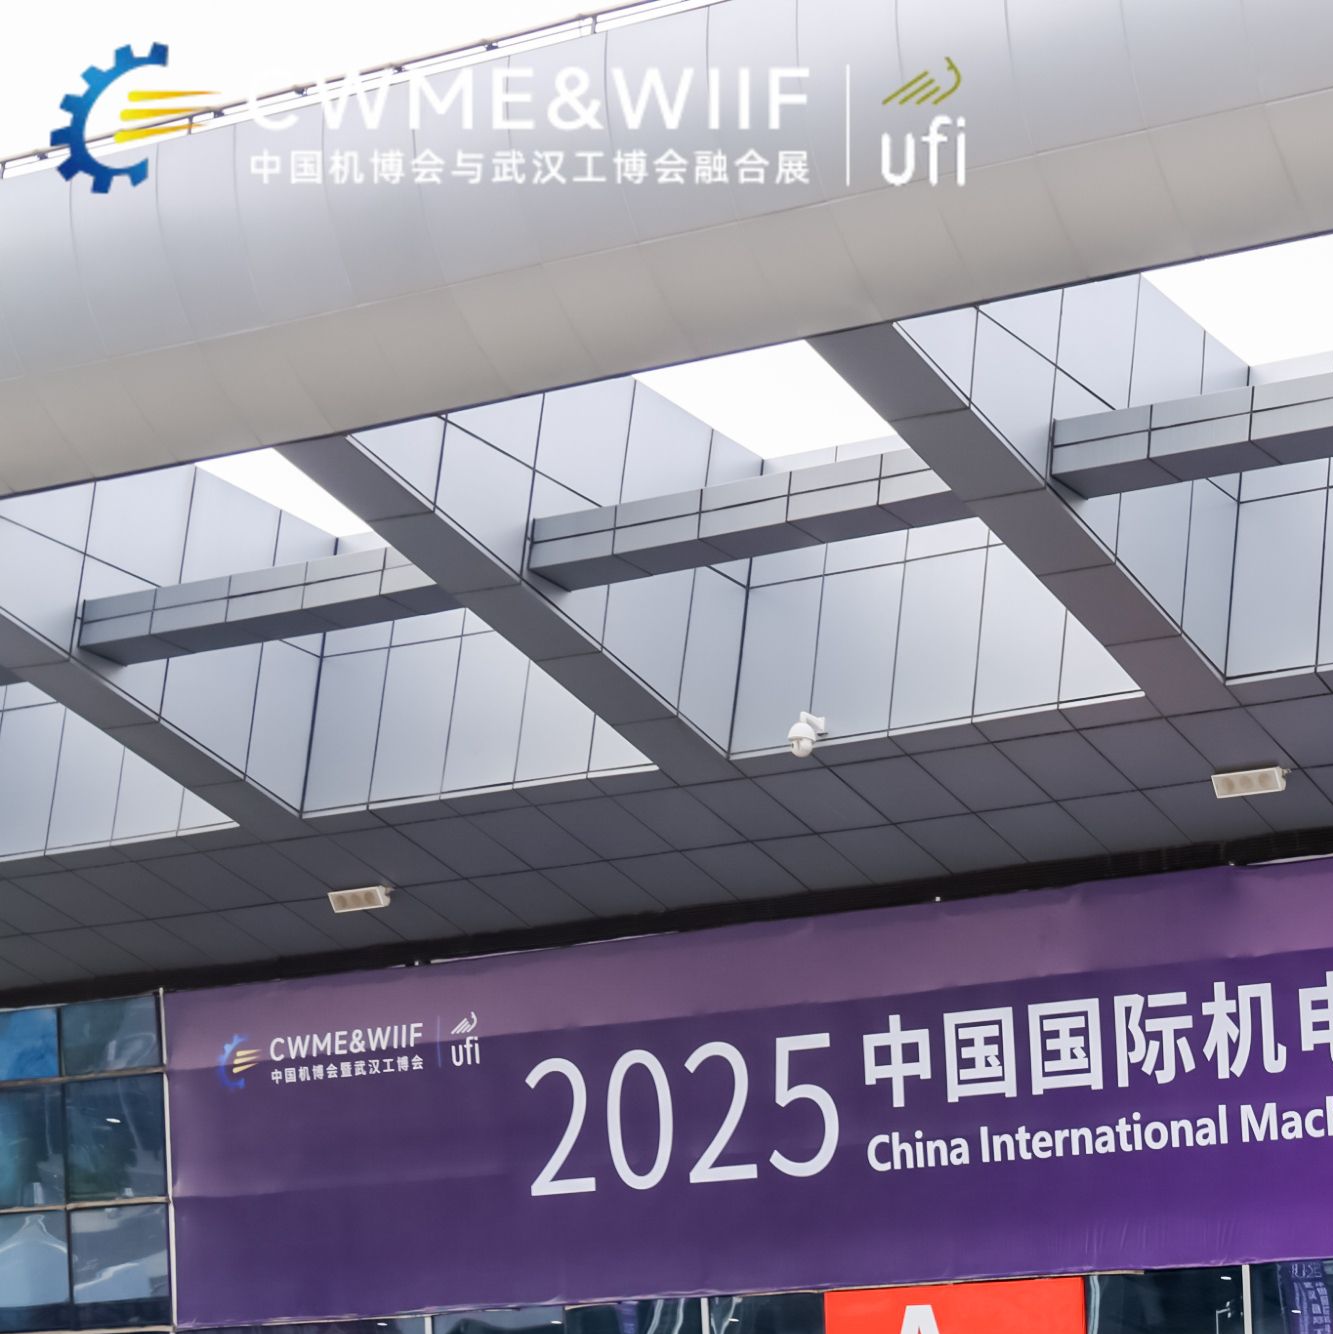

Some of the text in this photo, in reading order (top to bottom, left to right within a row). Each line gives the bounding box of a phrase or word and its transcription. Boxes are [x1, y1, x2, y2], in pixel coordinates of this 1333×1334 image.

[269, 1022, 481, 1067] CWME&WIIF ufi
[271, 1054, 424, 1085] 中国机博会暨武汉工博会
[525, 1032, 839, 1197] 2025
[867, 1130, 970, 1172] China
[979, 1104, 1229, 1163] International
